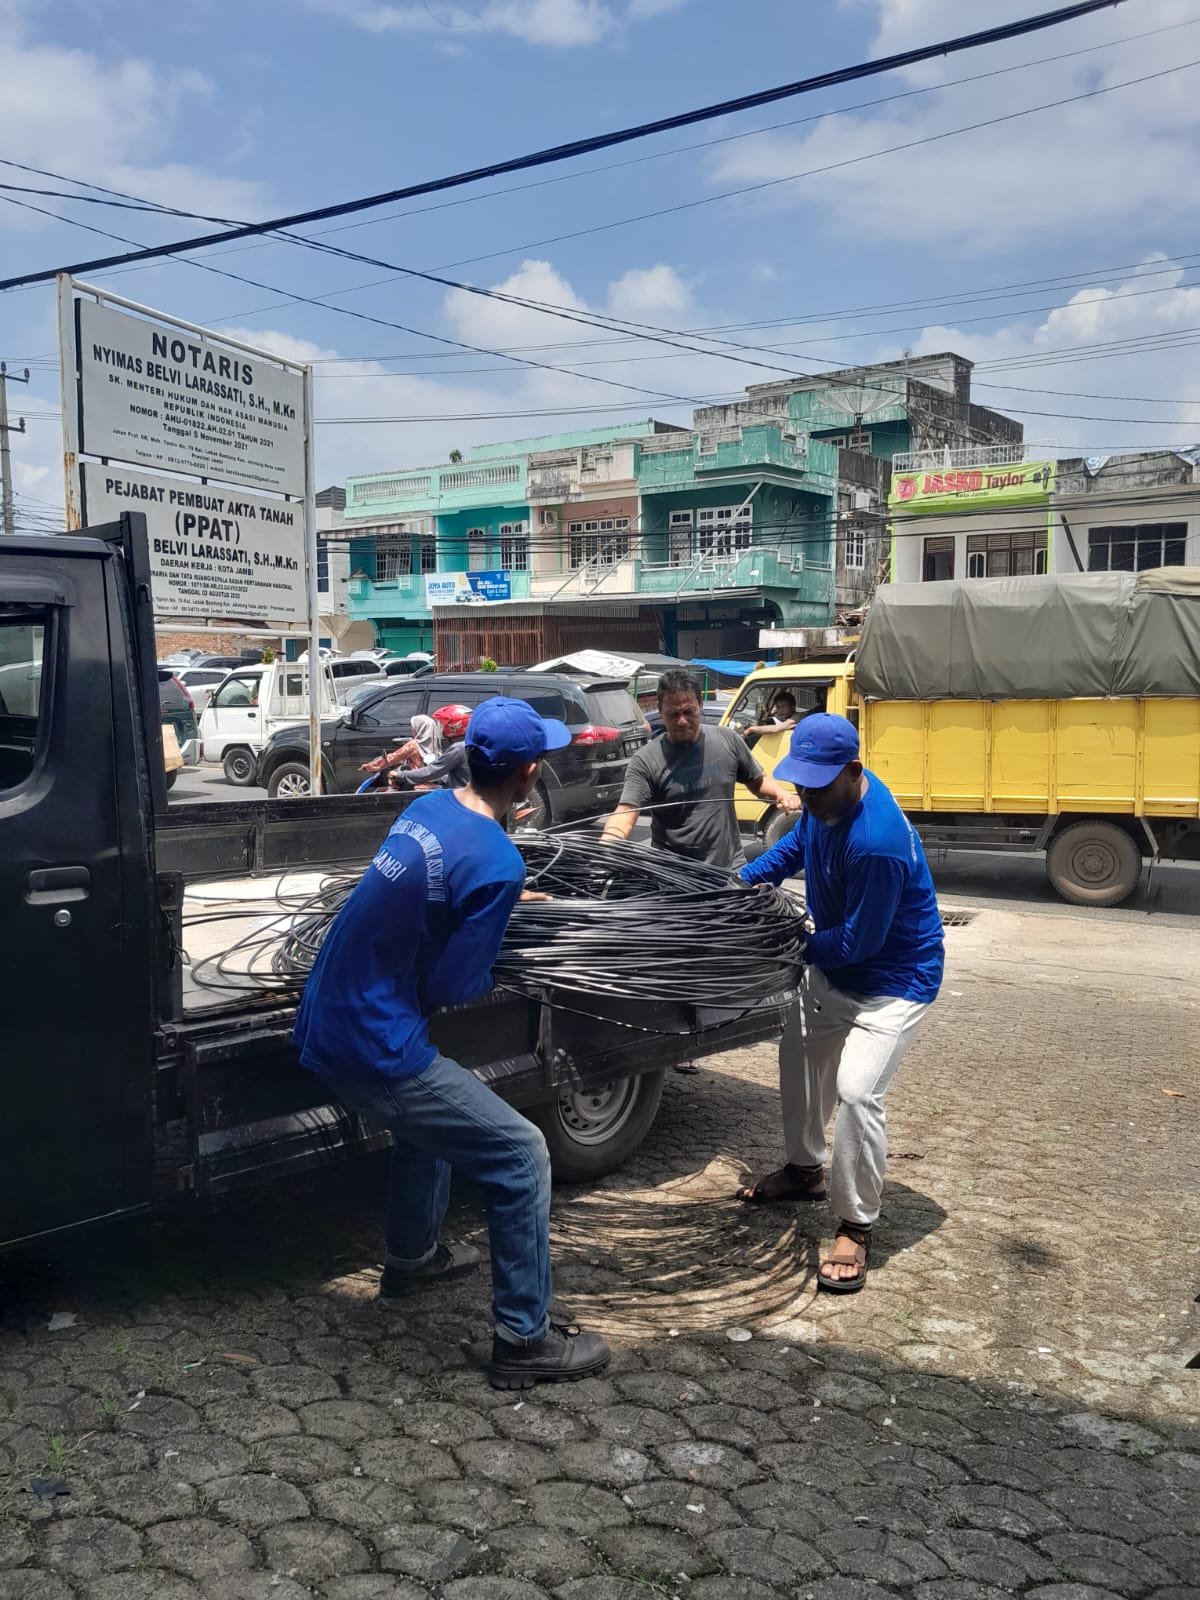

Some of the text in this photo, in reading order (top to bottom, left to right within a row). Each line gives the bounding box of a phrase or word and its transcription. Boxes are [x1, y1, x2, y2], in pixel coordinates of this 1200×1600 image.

[152, 331, 253, 386] NOTARIS
[93, 344, 143, 374] NYIMAS
[146, 361, 181, 386] BELVI
[185, 372, 246, 408] LARASSATI,
[273, 400, 296, 420] M.Kn
[108, 374, 288, 431] SK. MENTERI HUKUM DAN HAK ASASI MANUSIA
[163, 401, 247, 430] REPUBLIK INDONESIA
[129, 403, 159, 418] NOMOR
[237, 431, 258, 443] TAHUN
[259, 438, 274, 448] 2021
[162, 422, 192, 437] Tanggal
[200, 432, 233, 447] November
[234, 440, 248, 451] 2021
[922, 470, 983, 494] JASKO
[986, 472, 1026, 491] Taylor
[105, 478, 294, 526] PEJABAT PEMBUAT AKTA TANAH
[175, 510, 240, 545] (PPAT)
[153, 538, 188, 557] BELVI
[191, 543, 251, 567] LARASSATI,
[160, 558, 189, 569] DAERAH
[191, 561, 213, 571] KERJA
[217, 565, 234, 574] KOTA
[235, 567, 254, 577] JAMBI
[150, 570, 168, 578] RARIA
[178, 587, 201, 596] TANGGAL
[372, 848, 407, 882] JAMBI
